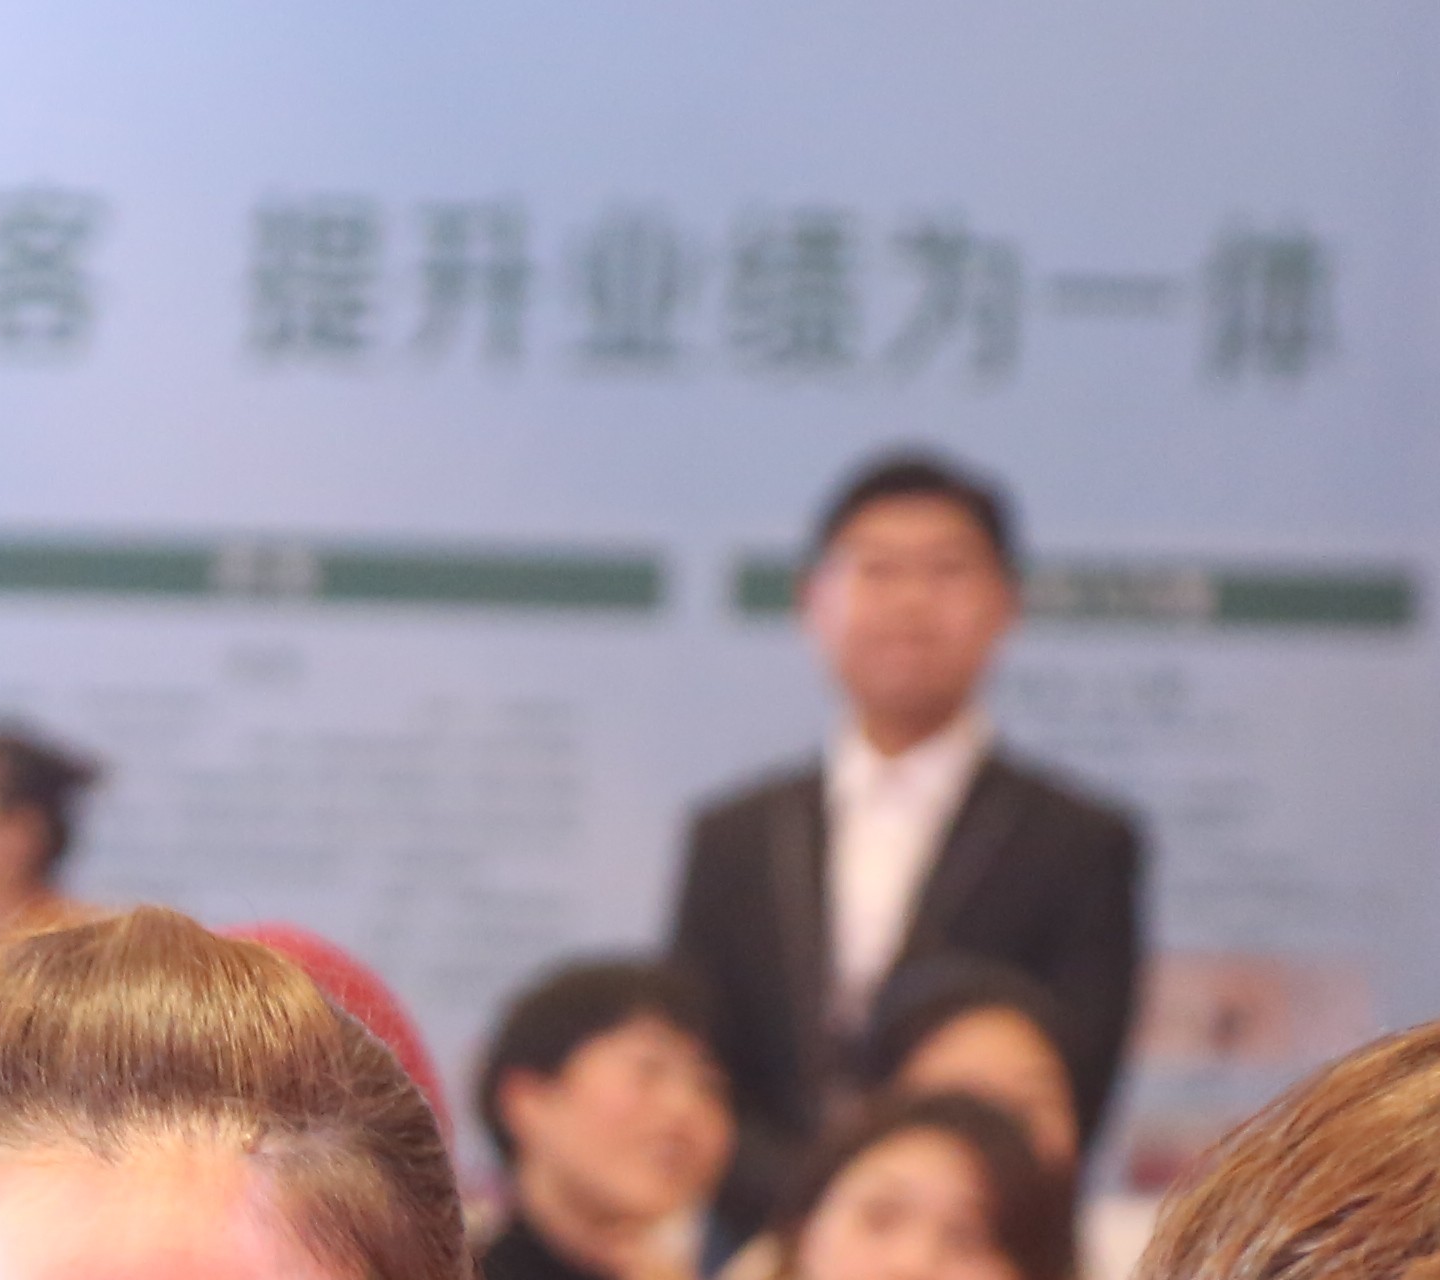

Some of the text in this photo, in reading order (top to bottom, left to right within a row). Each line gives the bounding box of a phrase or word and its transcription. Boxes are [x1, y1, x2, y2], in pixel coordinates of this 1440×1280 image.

[245, 196, 1334, 385] 提升业绩为一体
